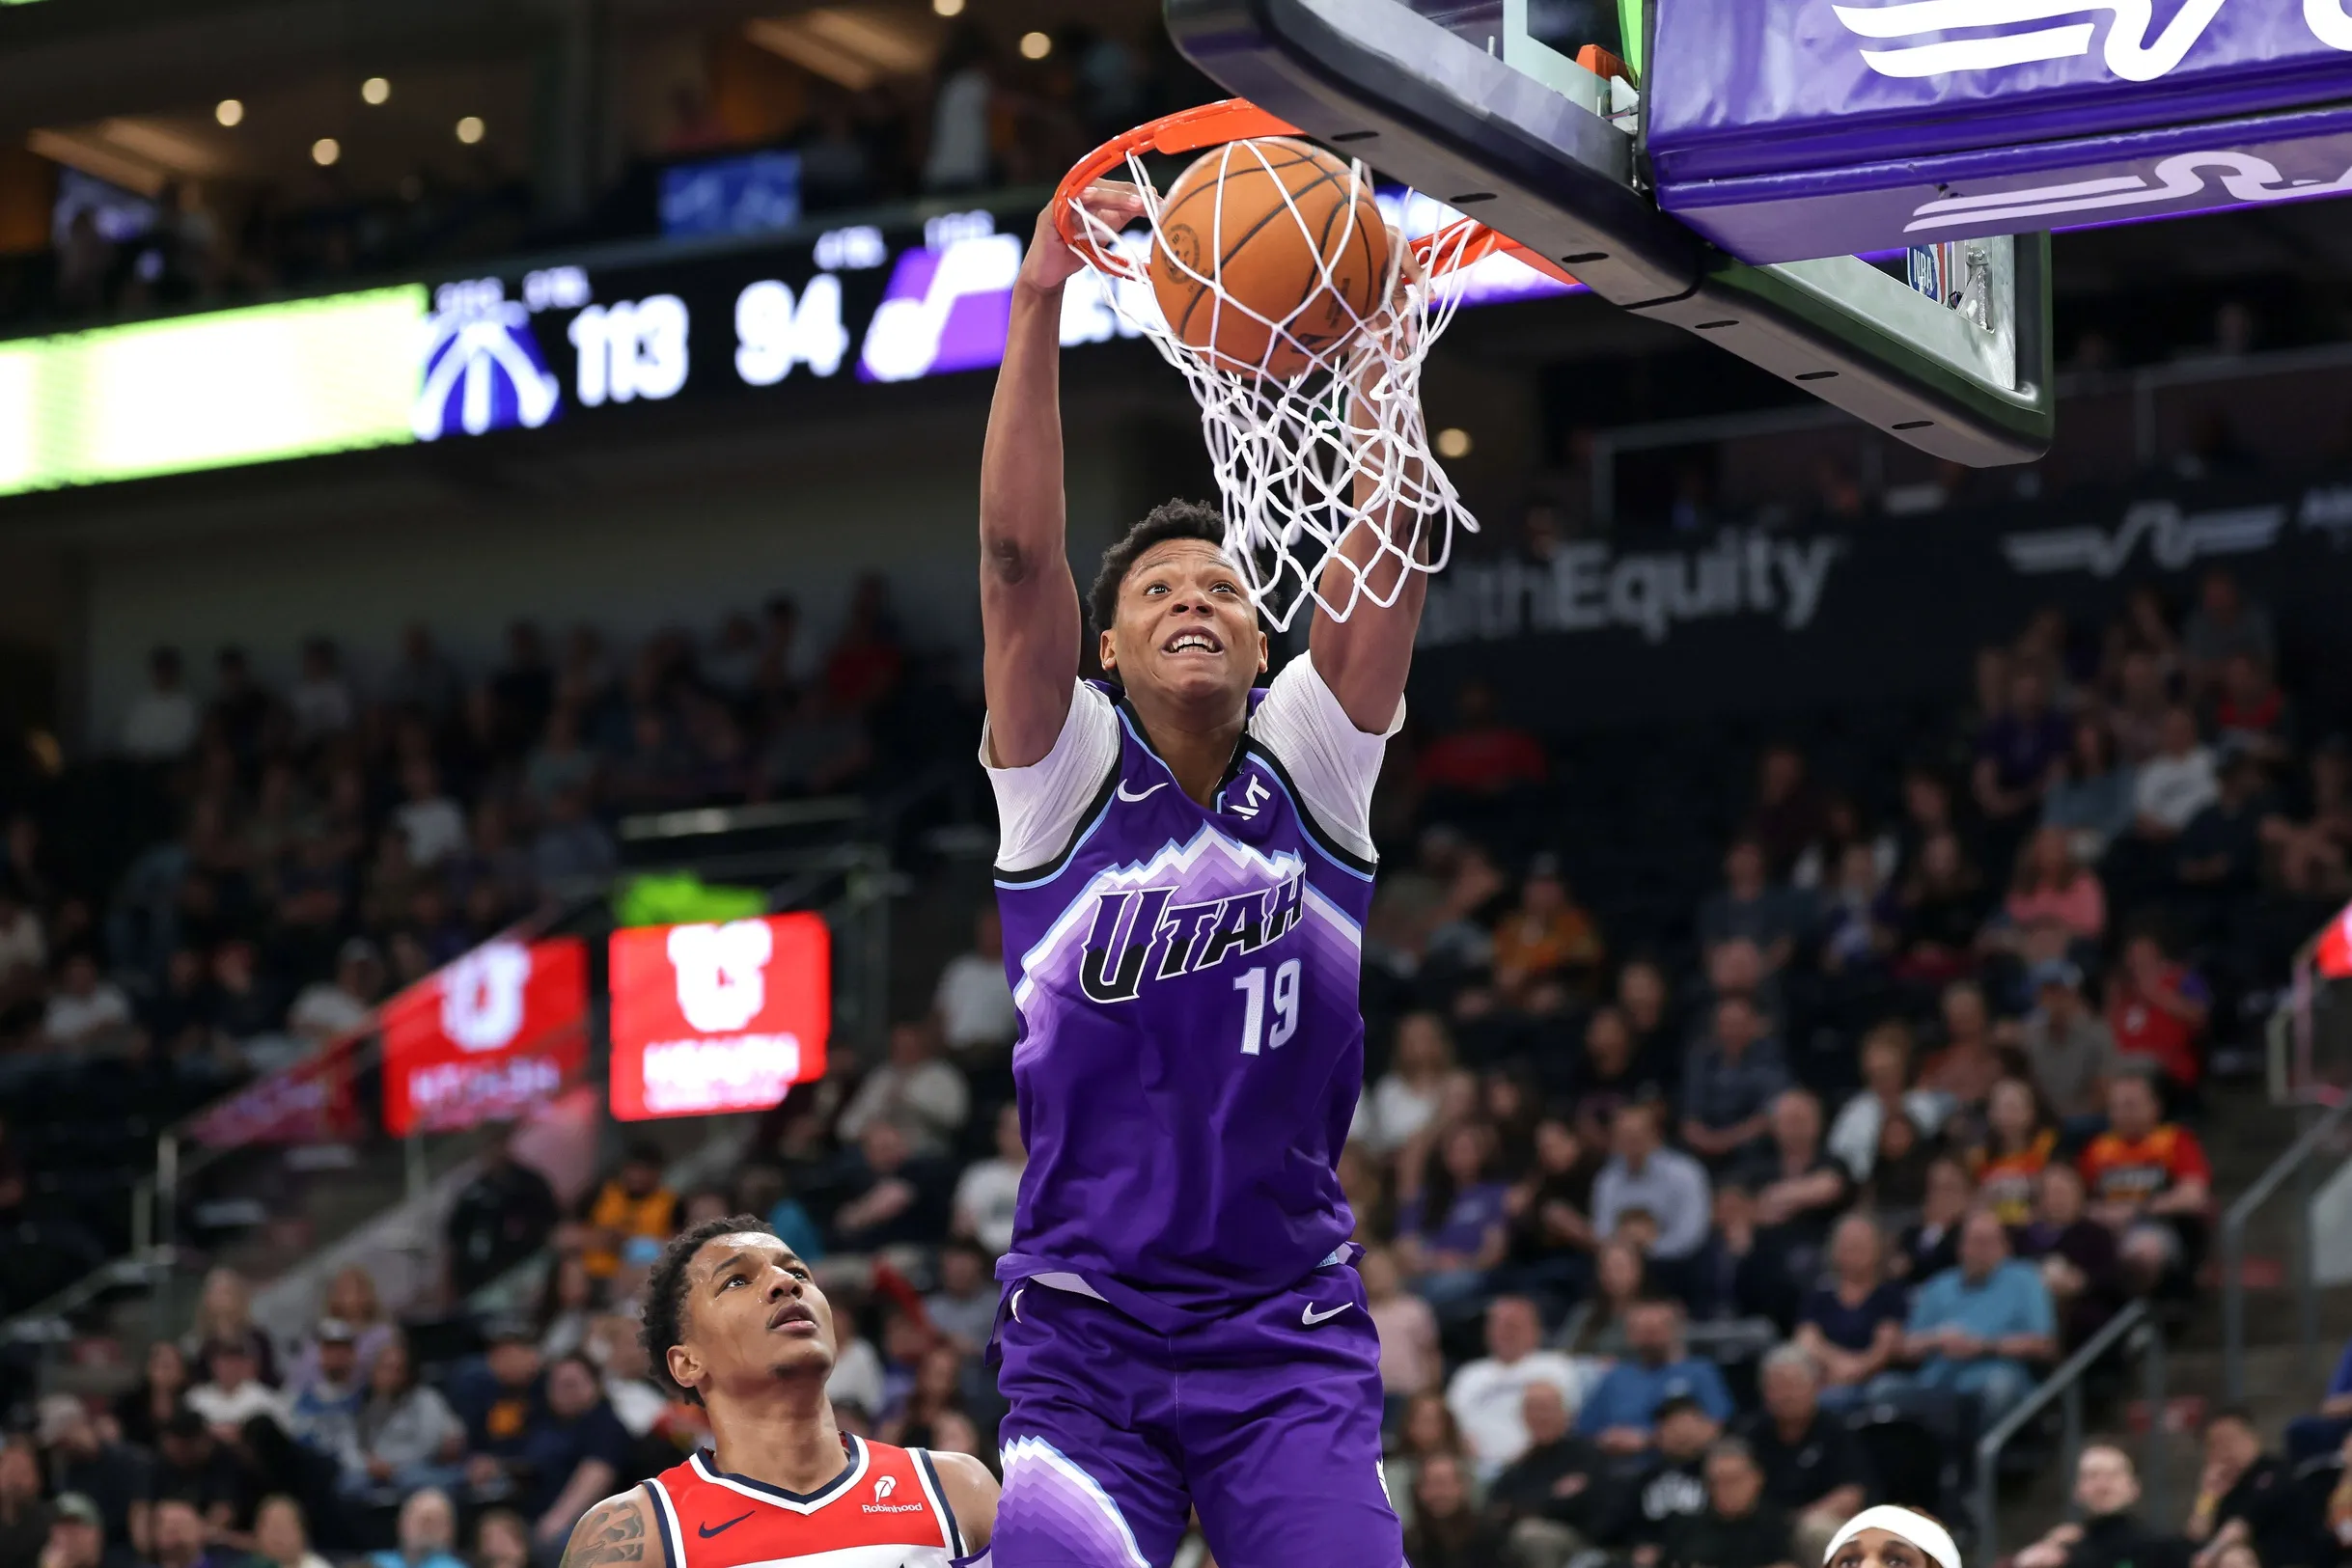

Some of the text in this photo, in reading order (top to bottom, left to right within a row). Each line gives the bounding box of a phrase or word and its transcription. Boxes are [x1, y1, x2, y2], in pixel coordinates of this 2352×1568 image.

[1913, 248, 1933, 291] NBA
[568, 293, 689, 406] 113
[734, 274, 847, 384] 94
[1079, 863, 1307, 1004] UTAH
[1232, 958, 1302, 1056] 19
[862, 1502, 924, 1513] Robinhood
